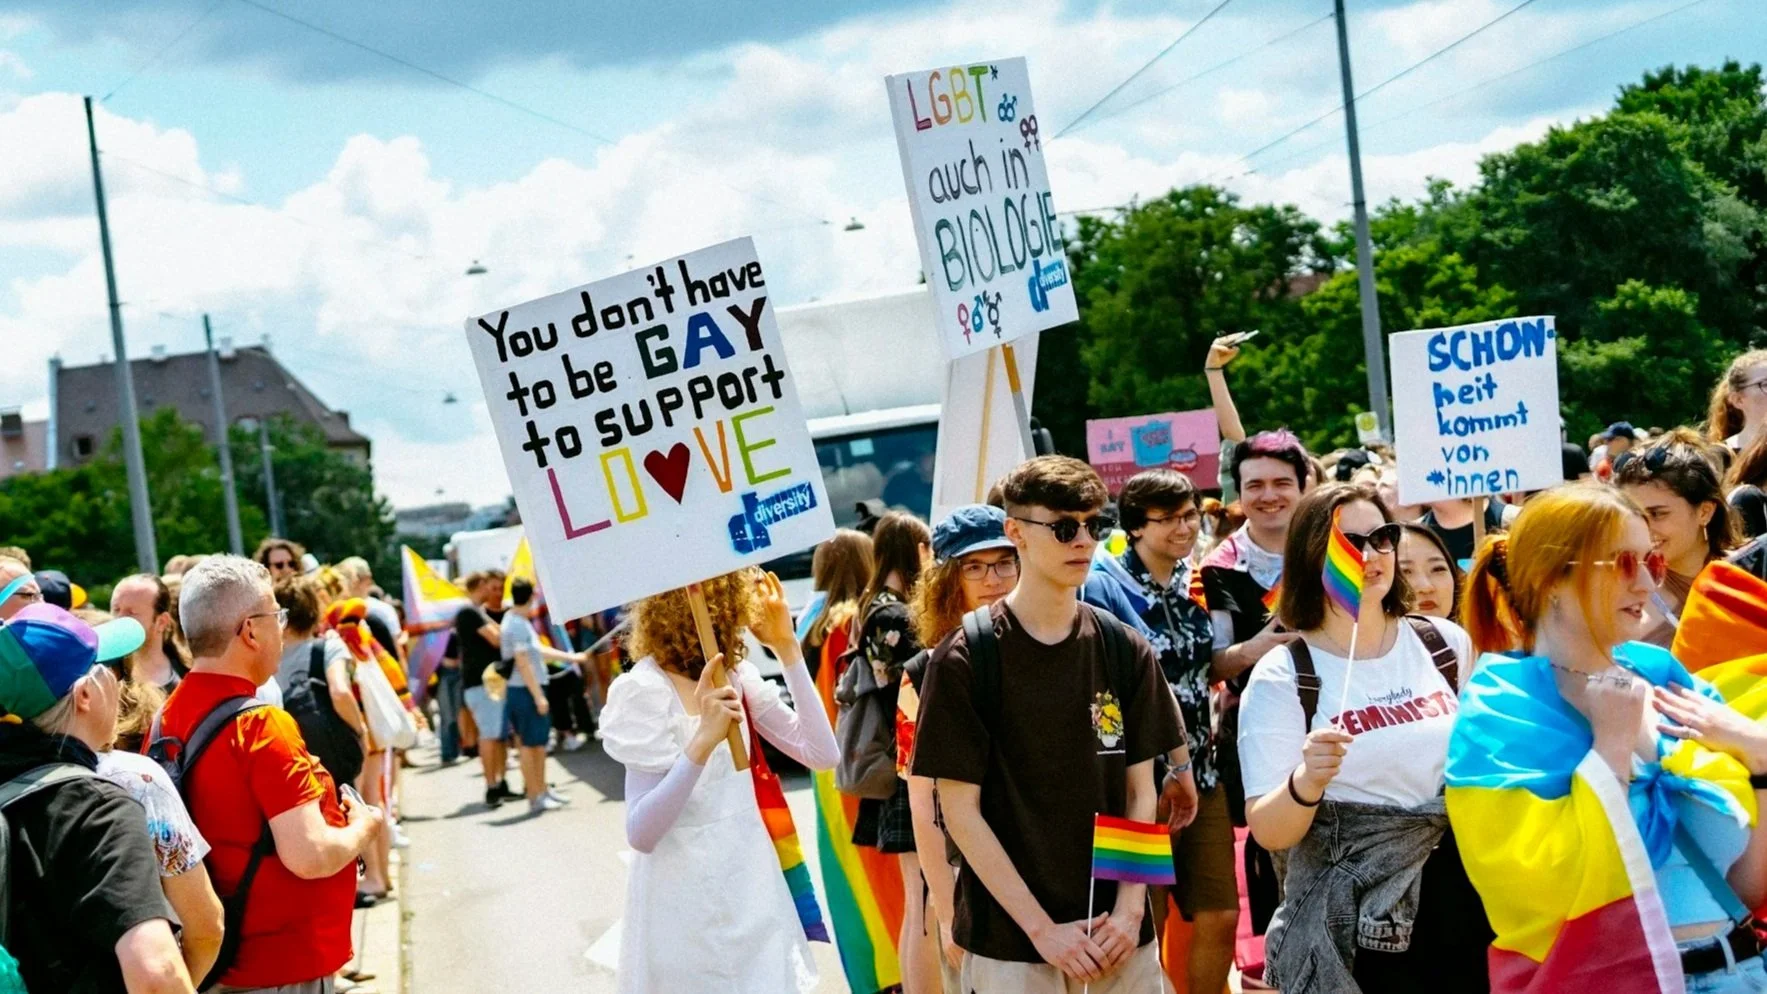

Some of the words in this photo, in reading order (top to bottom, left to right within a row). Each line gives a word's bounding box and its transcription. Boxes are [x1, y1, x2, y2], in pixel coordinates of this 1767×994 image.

[929, 138, 992, 204] auch
[999, 138, 1030, 190] in
[934, 191, 1063, 292] BIOLOGIE
[478, 311, 558, 362] You
[571, 266, 675, 338] don't
[678, 259, 765, 306] have
[506, 371, 557, 416] to
[561, 353, 617, 399] be
[634, 296, 767, 380] GAY
[522, 420, 582, 468] to
[594, 354, 785, 447] support
[1436, 400, 1528, 437] kommt
[1441, 444, 1489, 463] von
[753, 482, 812, 523] diversity
